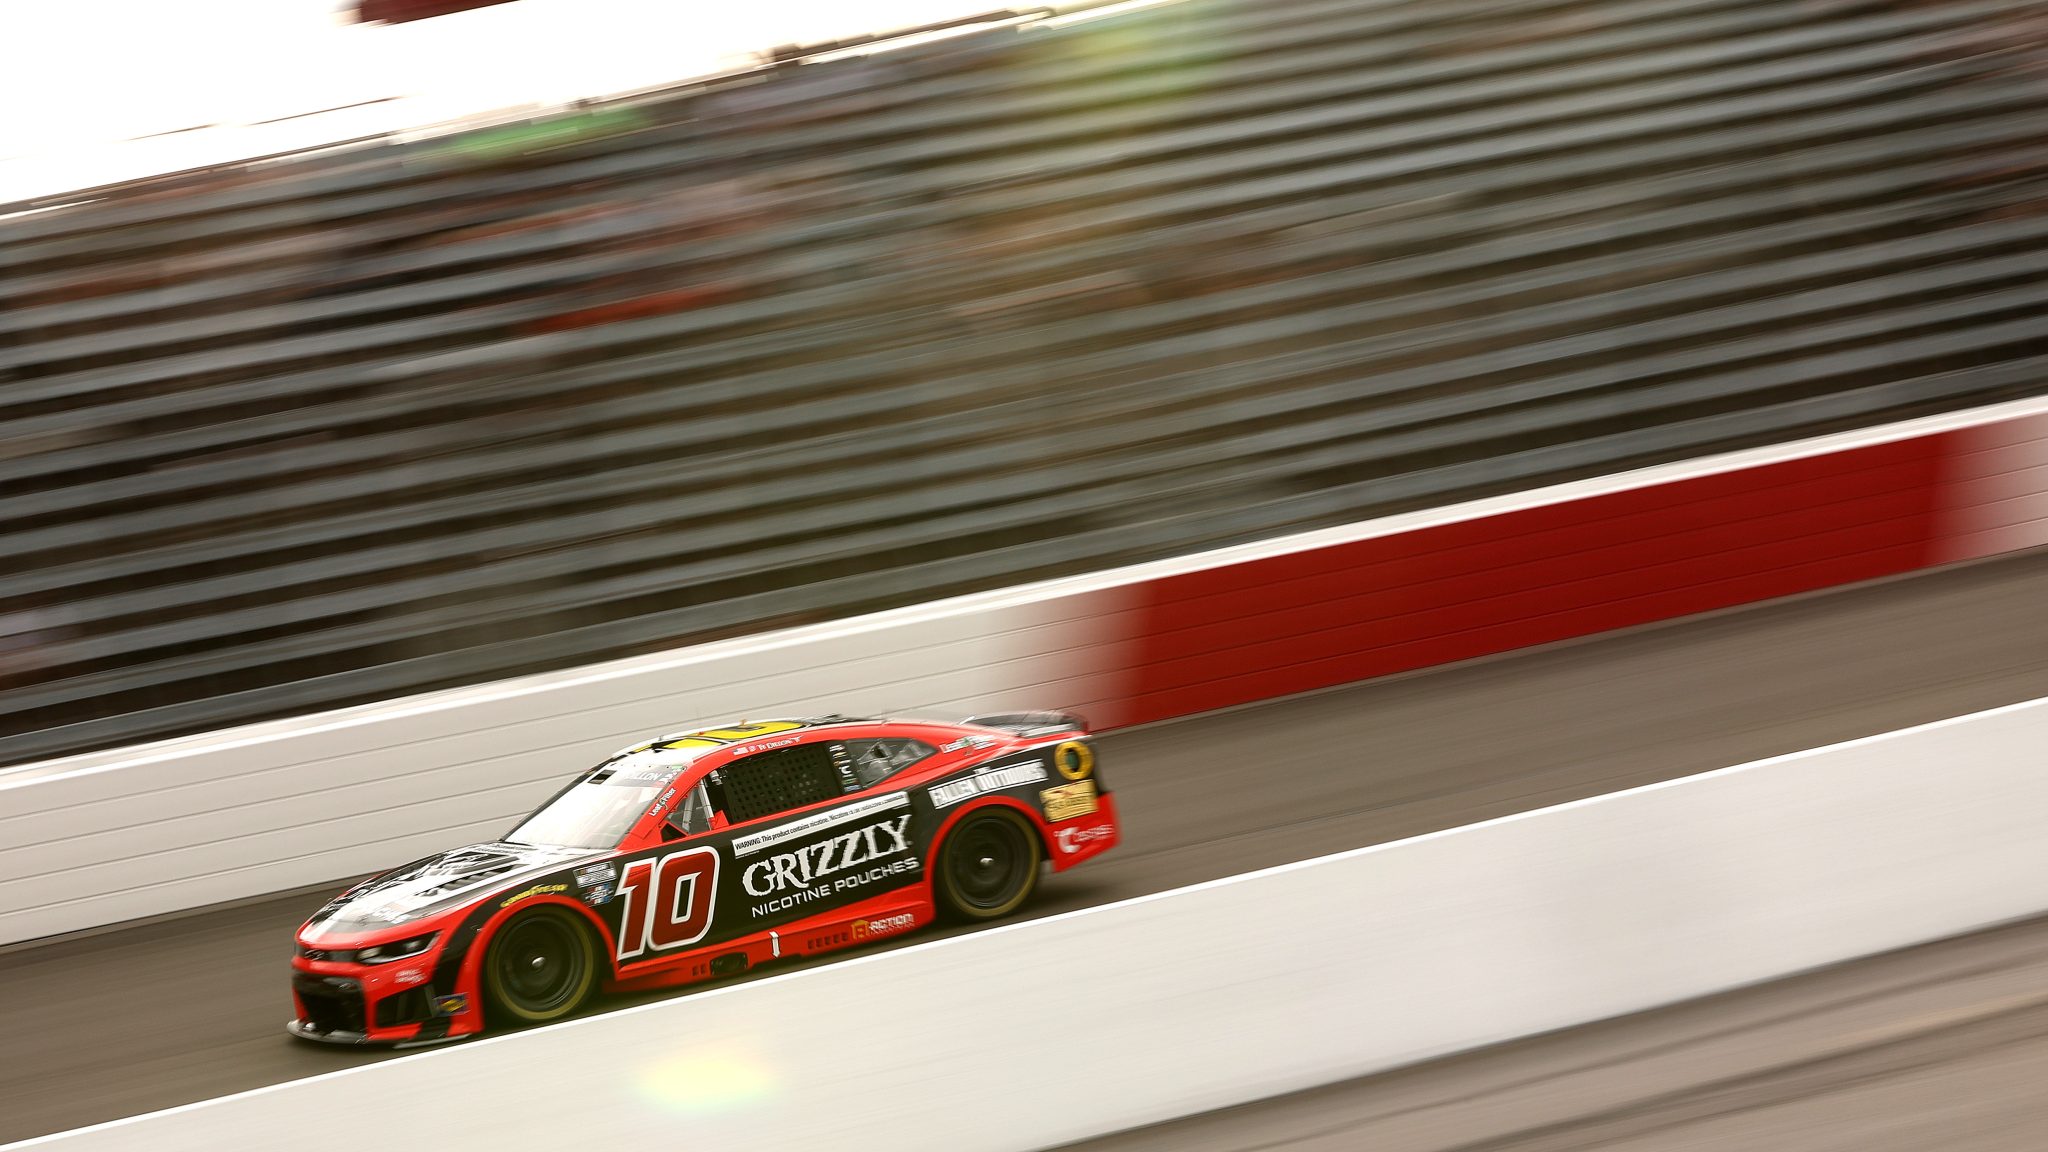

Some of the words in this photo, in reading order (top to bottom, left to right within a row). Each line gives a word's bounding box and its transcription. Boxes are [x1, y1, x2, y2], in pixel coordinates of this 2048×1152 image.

[735, 837, 761, 850] WARNING:
[761, 834, 773, 843] This
[772, 829, 790, 841] product
[790, 824, 810, 834] contains
[742, 814, 912, 897] GRIZZLY
[615, 845, 721, 961] 10
[752, 884, 831, 918] NICOTINE
[835, 857, 920, 892] POUCHES
